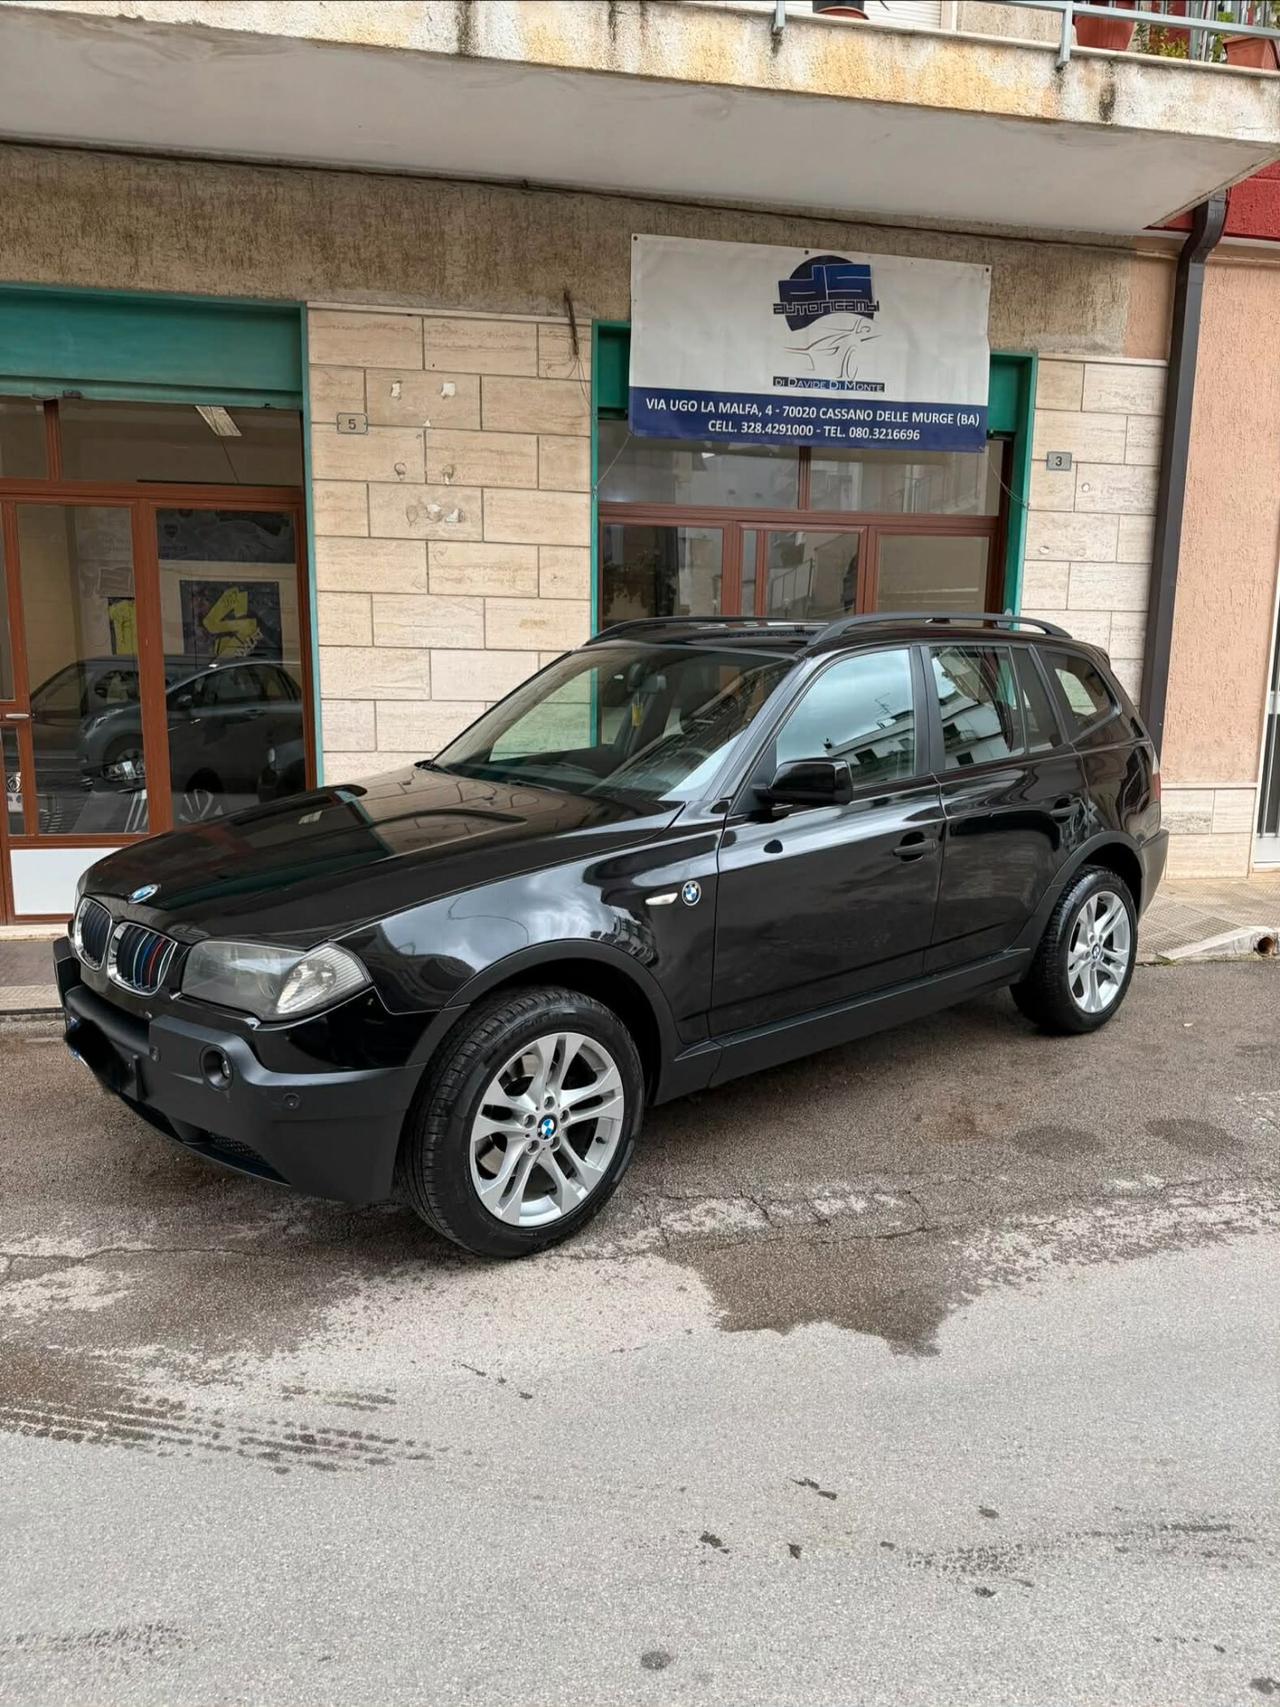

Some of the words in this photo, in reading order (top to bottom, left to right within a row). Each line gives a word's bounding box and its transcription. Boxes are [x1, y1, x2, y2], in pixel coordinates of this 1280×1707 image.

[645, 397, 667, 411] VIA
[669, 399, 698, 412] UGO
[700, 401, 715, 413] LA
[718, 402, 763, 417] MALFA,
[765, 404, 773, 416] 4
[782, 405, 817, 419] 70020
[819, 407, 873, 421] CASSANO
[876, 410, 909, 423] DELLE
[911, 412, 954, 424] MURGE
[956, 412, 980, 427] (BA)
[348, 418, 357, 430] 5
[708, 419, 738, 433] CELL.
[740, 421, 814, 436] 328.4291000
[823, 425, 846, 438] TEL.
[849, 427, 921, 441] 080.3216696
[1055, 455, 1063, 467] 3
